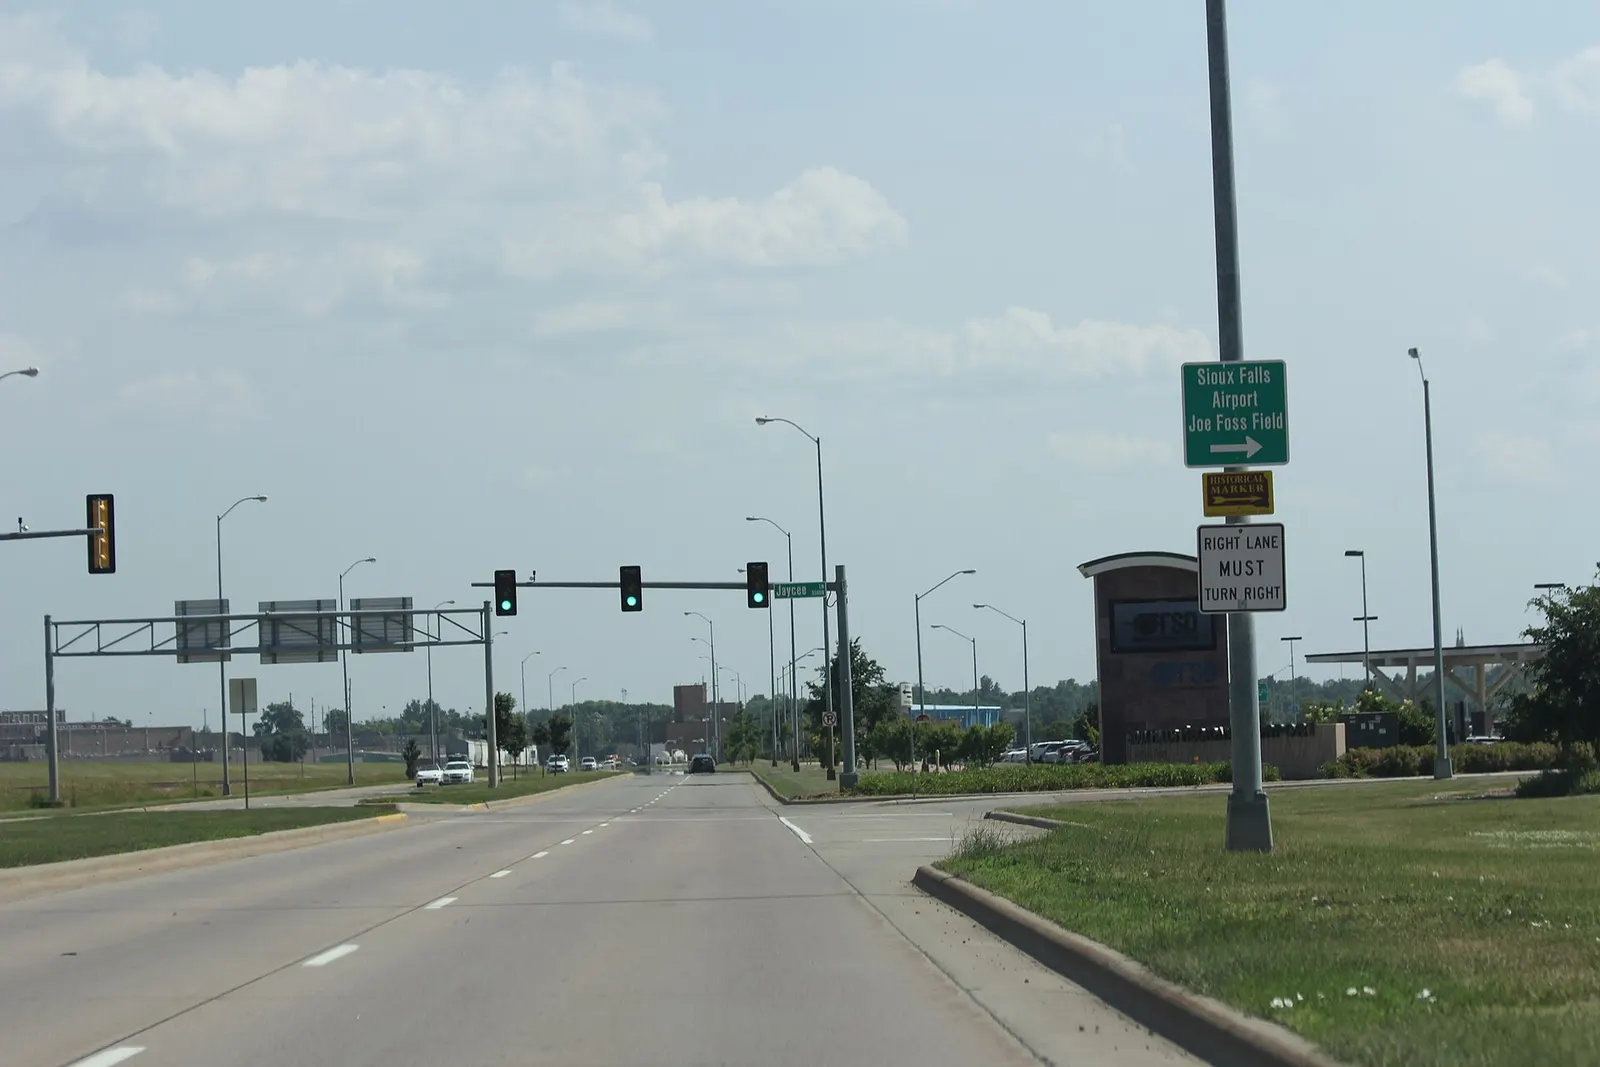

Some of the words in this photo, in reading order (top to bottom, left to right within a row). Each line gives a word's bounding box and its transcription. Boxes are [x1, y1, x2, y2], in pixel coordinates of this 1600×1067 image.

[1197, 368, 1235, 385] Sioux
[1240, 366, 1271, 384] Falls
[1212, 390, 1258, 410] Airport
[1189, 414, 1211, 432] Joe
[1216, 414, 1247, 431] Foss
[1252, 412, 1283, 430] Field
[1210, 474, 1265, 485] HISTORICAL
[1210, 484, 1264, 494] MARKER
[1204, 536, 1240, 550] RIGHT
[1247, 535, 1278, 549] LANE
[1220, 560, 1264, 577] MUST
[776, 584, 807, 597] Jaycee
[1204, 587, 1237, 601] TURN
[1244, 586, 1280, 600] RIGHT
